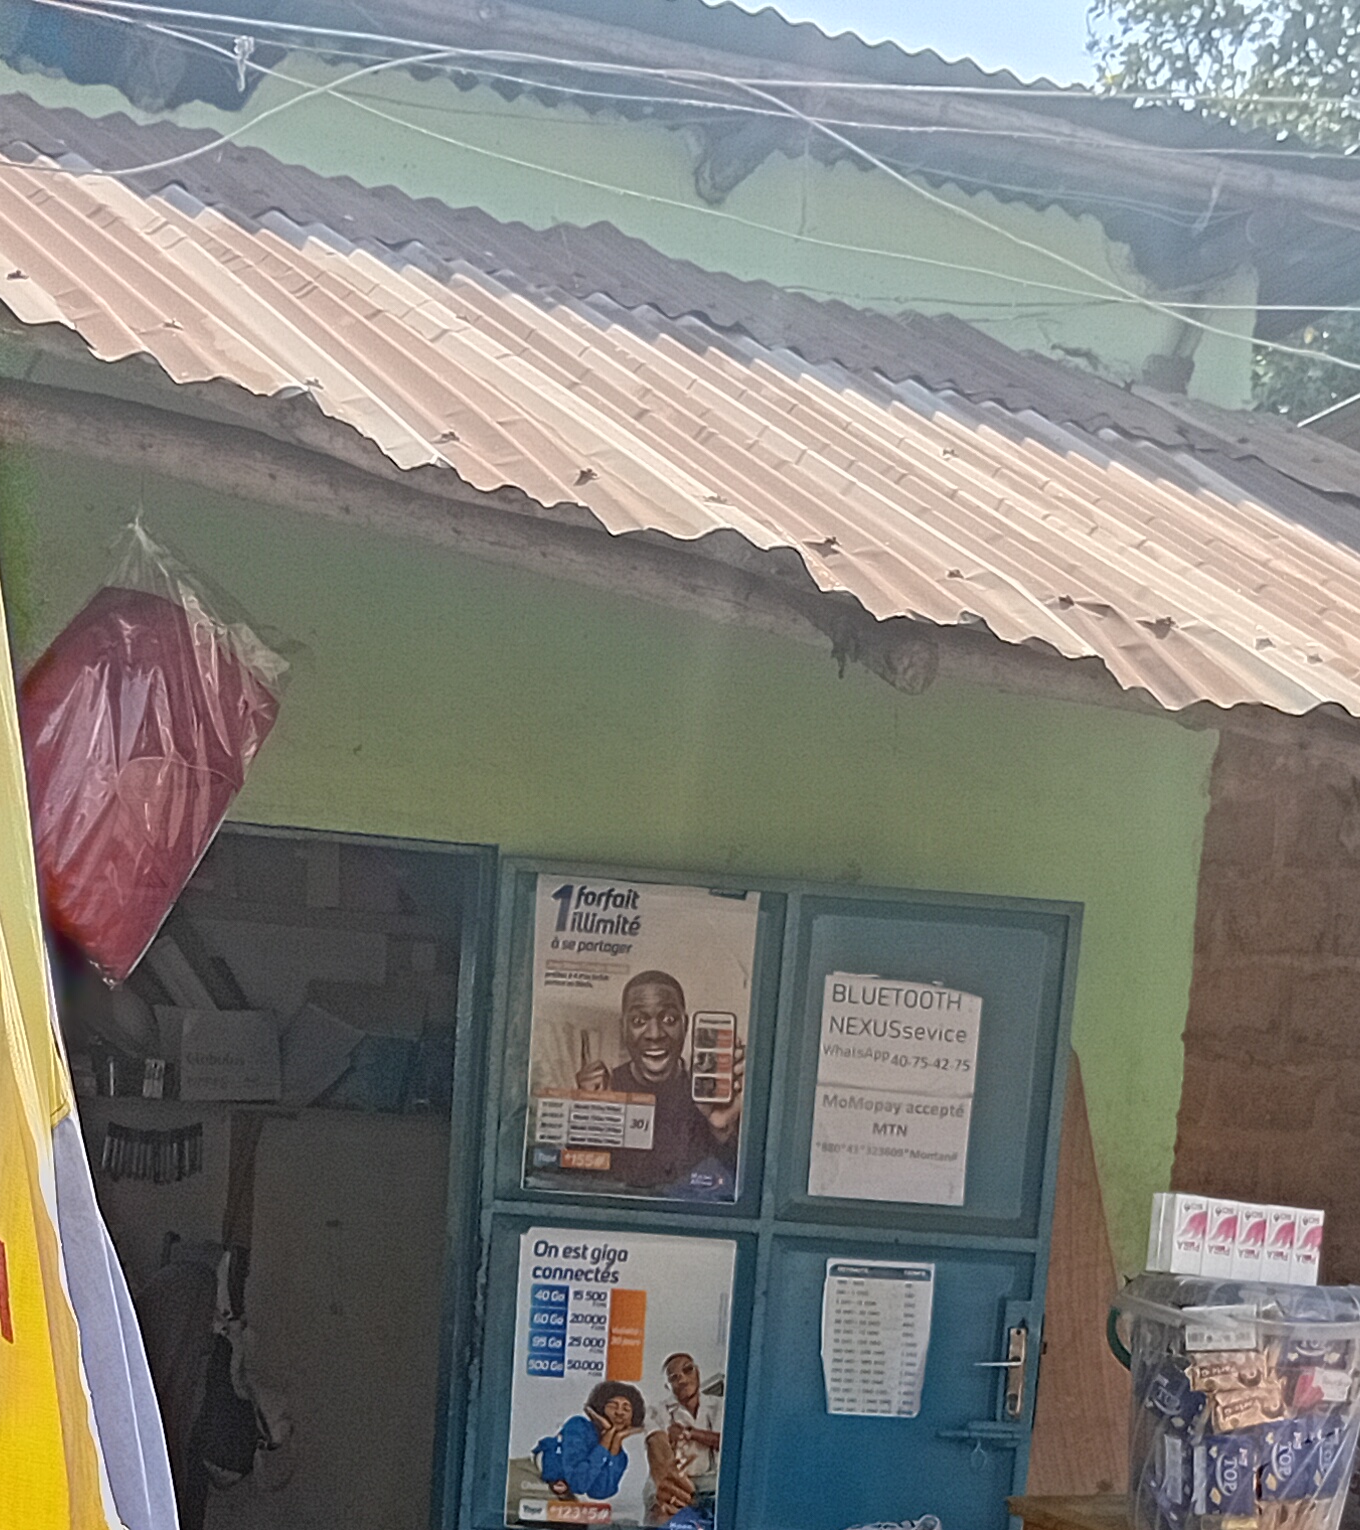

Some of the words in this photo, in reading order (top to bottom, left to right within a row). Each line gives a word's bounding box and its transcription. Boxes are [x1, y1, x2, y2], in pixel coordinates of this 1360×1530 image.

[575, 886, 641, 911] forfait
[570, 911, 642, 937] illimité
[561, 939, 576, 950] se
[576, 941, 633, 957] partager
[832, 983, 963, 1011] BLUETOOTH
[829, 1016, 968, 1043] NEXUSsevice
[822, 1043, 890, 1062] WhatsApp
[822, 1093, 904, 1116] MoMopay
[905, 1101, 965, 1119] accepté
[871, 1122, 908, 1138] MTN
[533, 1240, 560, 1259] On
[562, 1244, 588, 1260] est
[590, 1244, 629, 1265] giga
[532, 1263, 620, 1284] connectés
[1223, 1455, 1239, 1493] TOP
